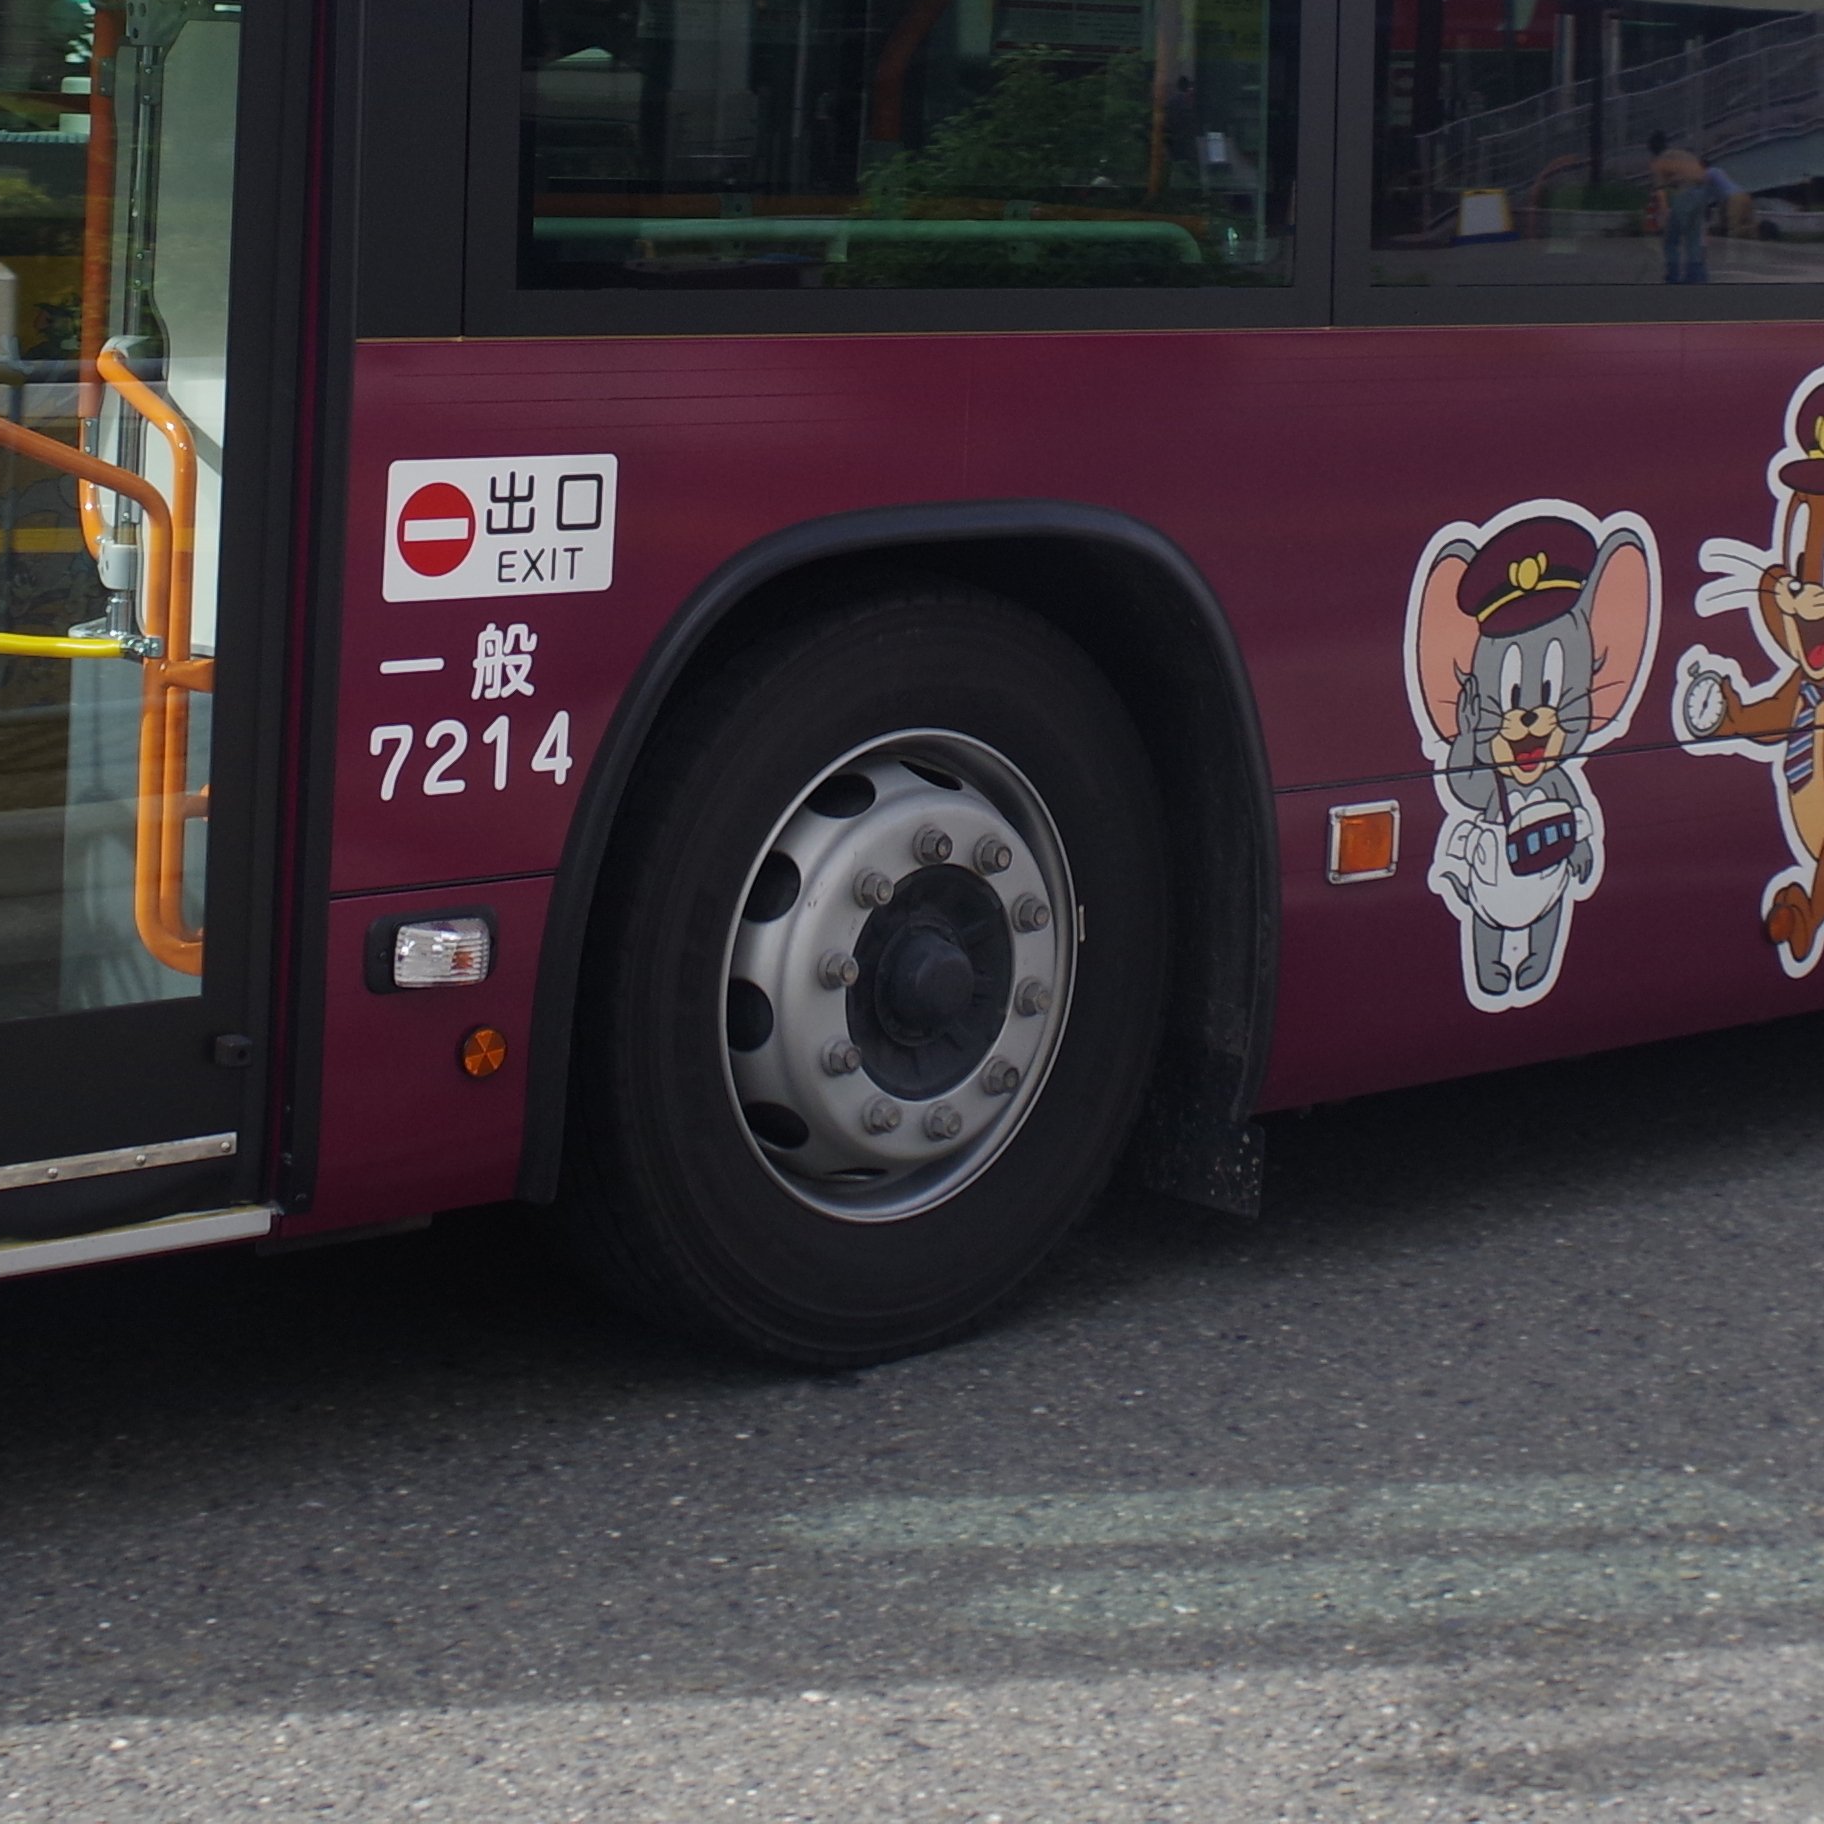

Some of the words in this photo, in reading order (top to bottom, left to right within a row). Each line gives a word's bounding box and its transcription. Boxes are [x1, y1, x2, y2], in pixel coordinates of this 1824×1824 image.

[485, 470, 604, 536] 出口
[497, 546, 585, 584] EXIT
[379, 622, 537, 701] 一般
[369, 709, 574, 802] 7214
